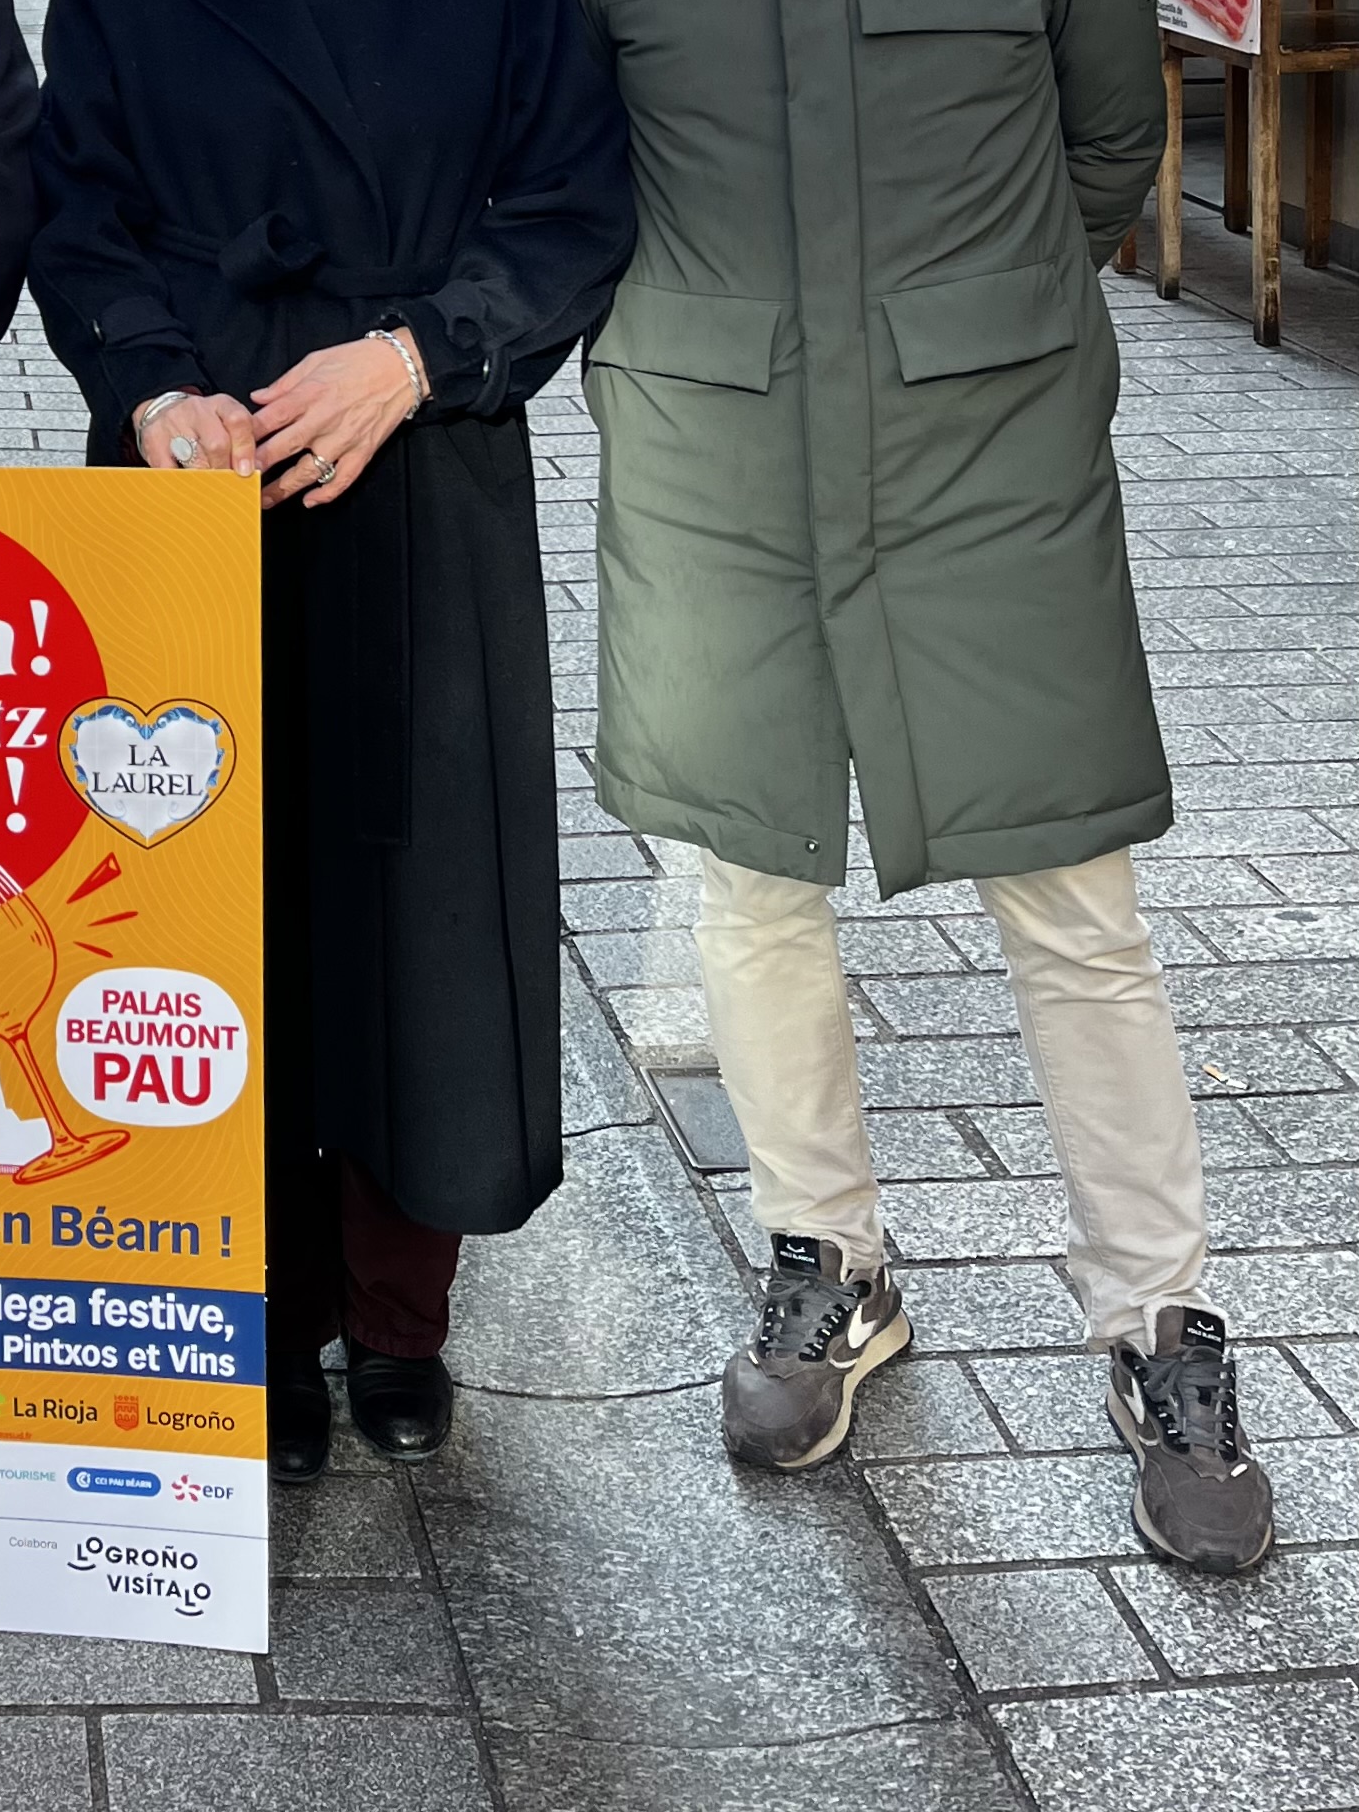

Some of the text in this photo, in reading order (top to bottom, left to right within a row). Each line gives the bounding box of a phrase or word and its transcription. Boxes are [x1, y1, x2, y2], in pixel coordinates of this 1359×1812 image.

[127, 744, 170, 767] LA
[91, 771, 204, 797] LAUREL
[102, 989, 202, 1018] PALAIS
[66, 1018, 240, 1050] BEAUMONT
[93, 1052, 211, 1107] PAU
[51, 1205, 200, 1256] Béarn
[88, 1288, 235, 1342] festive,
[3, 1334, 236, 1377] Pintxos et Vins
[13, 1397, 98, 1424] La Rioja
[146, 1406, 235, 1431] Logroño
[0, 1469, 56, 1482] TOURISME
[94, 1475, 108, 1486] CCI
[108, 1477, 125, 1487] PAU
[9, 1536, 58, 1550] Colabora
[76, 1536, 198, 1570] LOGROÑO
[106, 1572, 211, 1607] VISÍTALO
